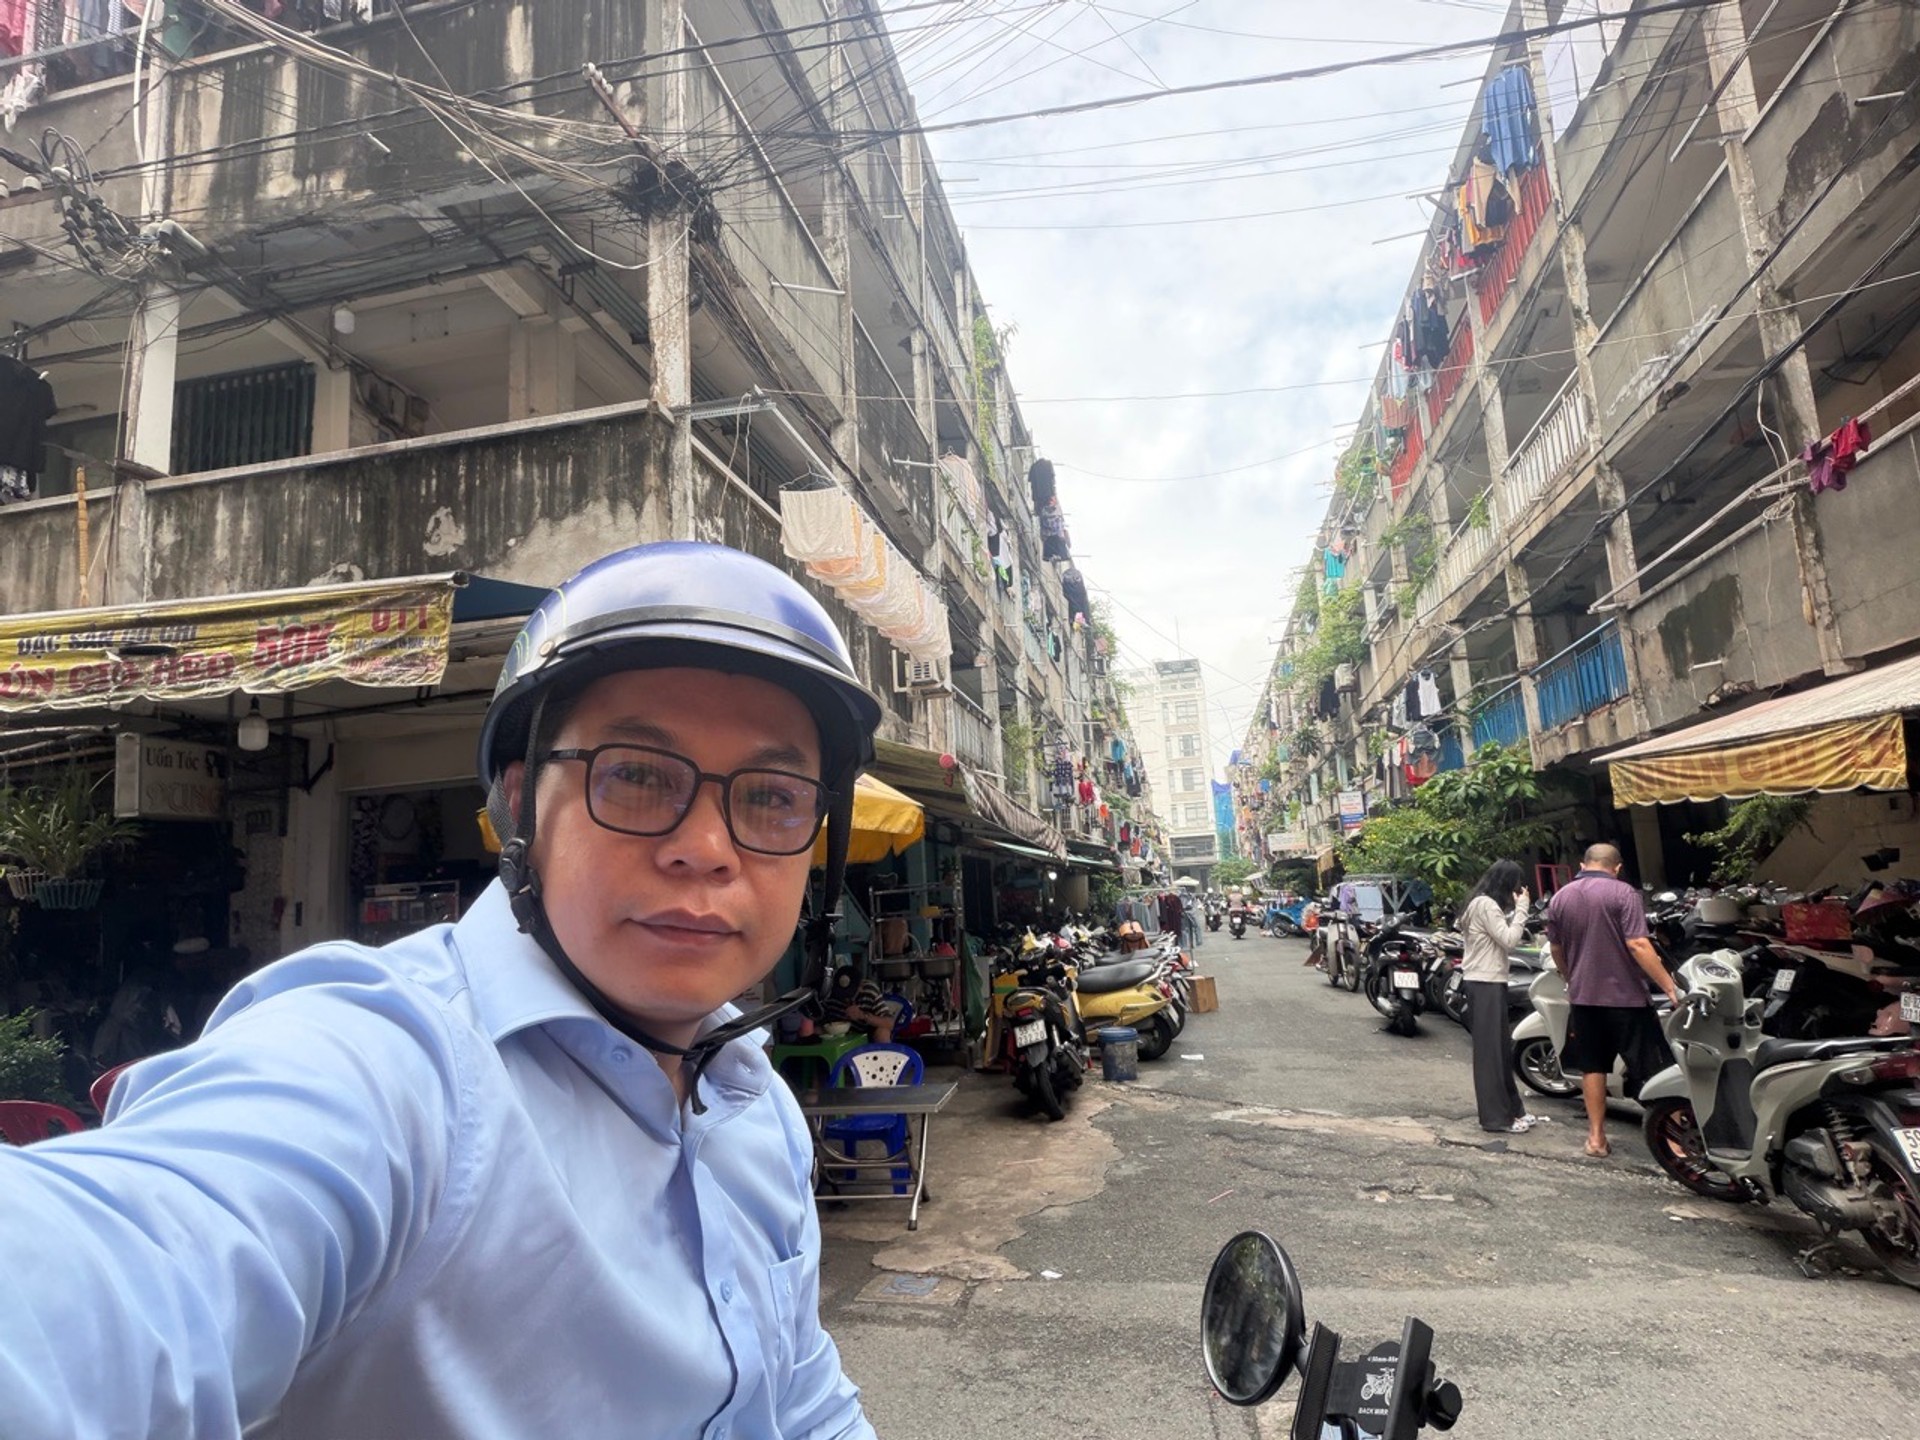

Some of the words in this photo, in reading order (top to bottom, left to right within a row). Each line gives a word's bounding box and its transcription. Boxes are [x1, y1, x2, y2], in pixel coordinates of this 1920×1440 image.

[254, 623, 336, 668] 50K
[149, 652, 236, 686] HEO
[146, 746, 173, 768] Uốn
[177, 751, 200, 771] Tóc
